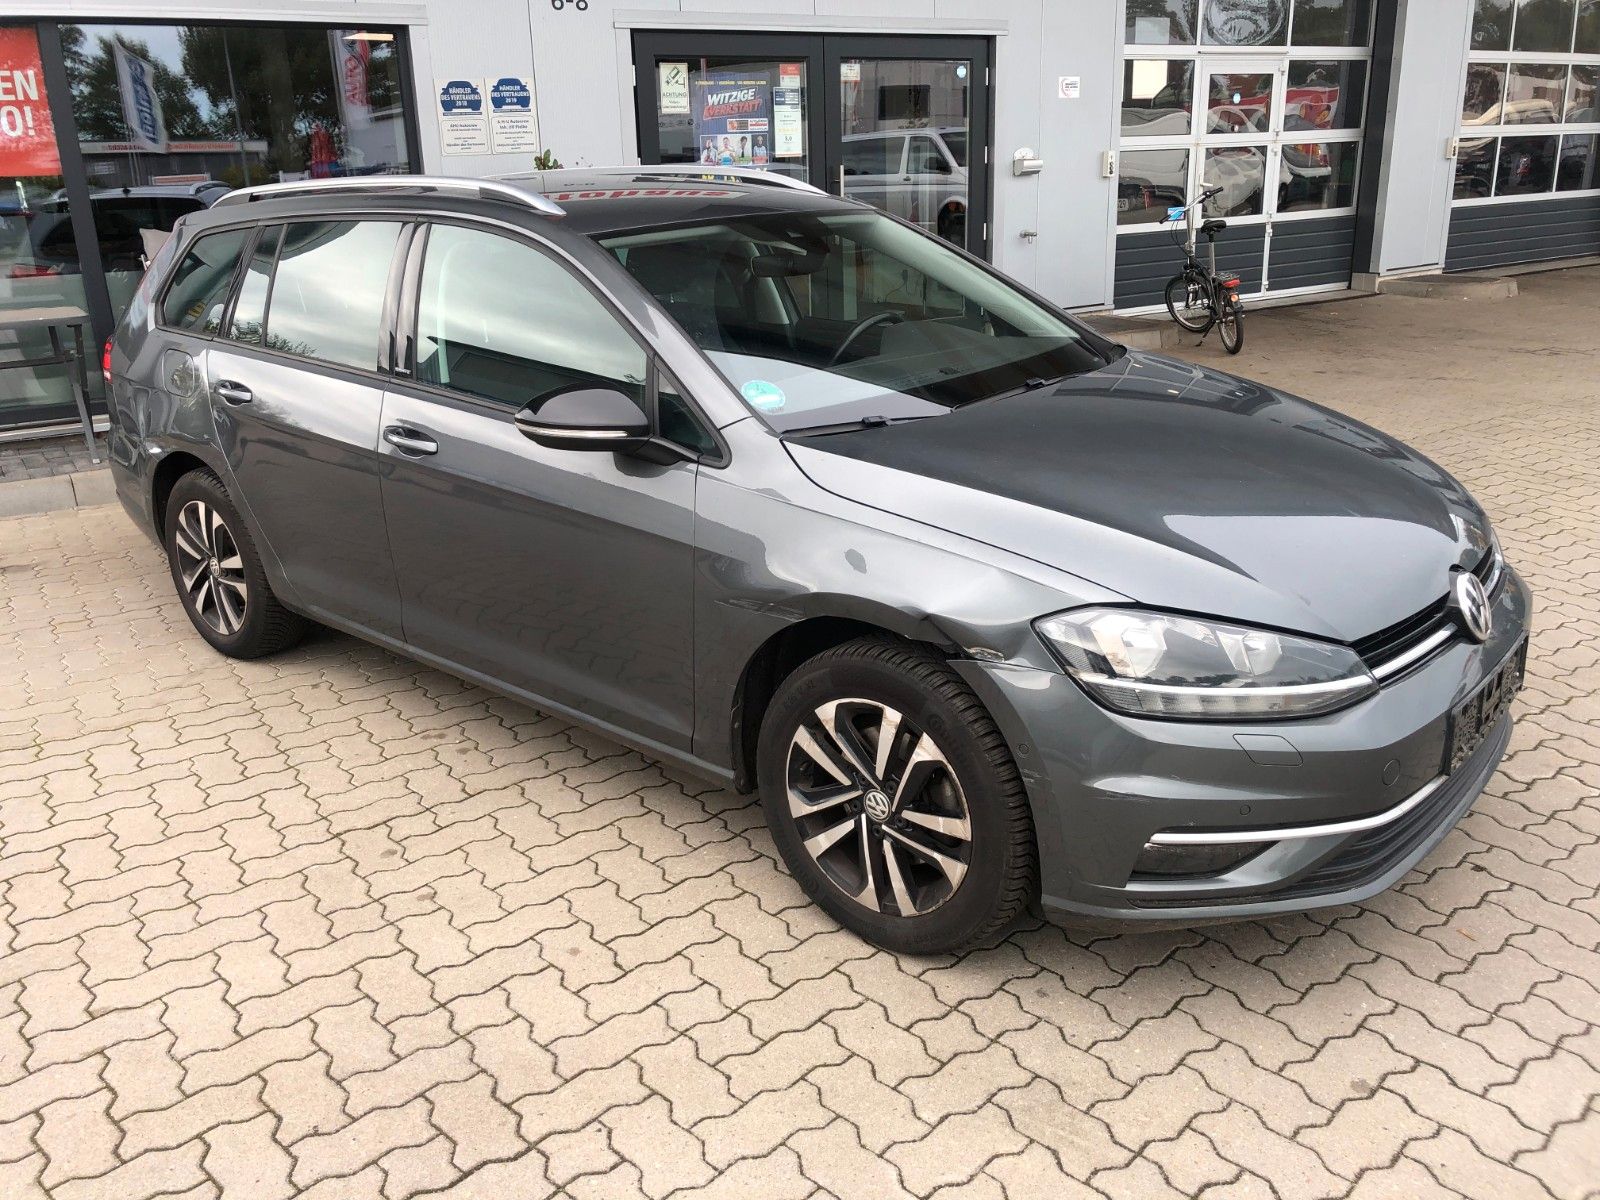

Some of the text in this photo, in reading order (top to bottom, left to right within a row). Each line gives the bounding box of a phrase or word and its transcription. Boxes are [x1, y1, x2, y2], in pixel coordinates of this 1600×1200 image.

[707, 88, 756, 105] WITZIGE
[706, 100, 759, 117] WERKSTATT
[0, 105, 36, 137] O!
